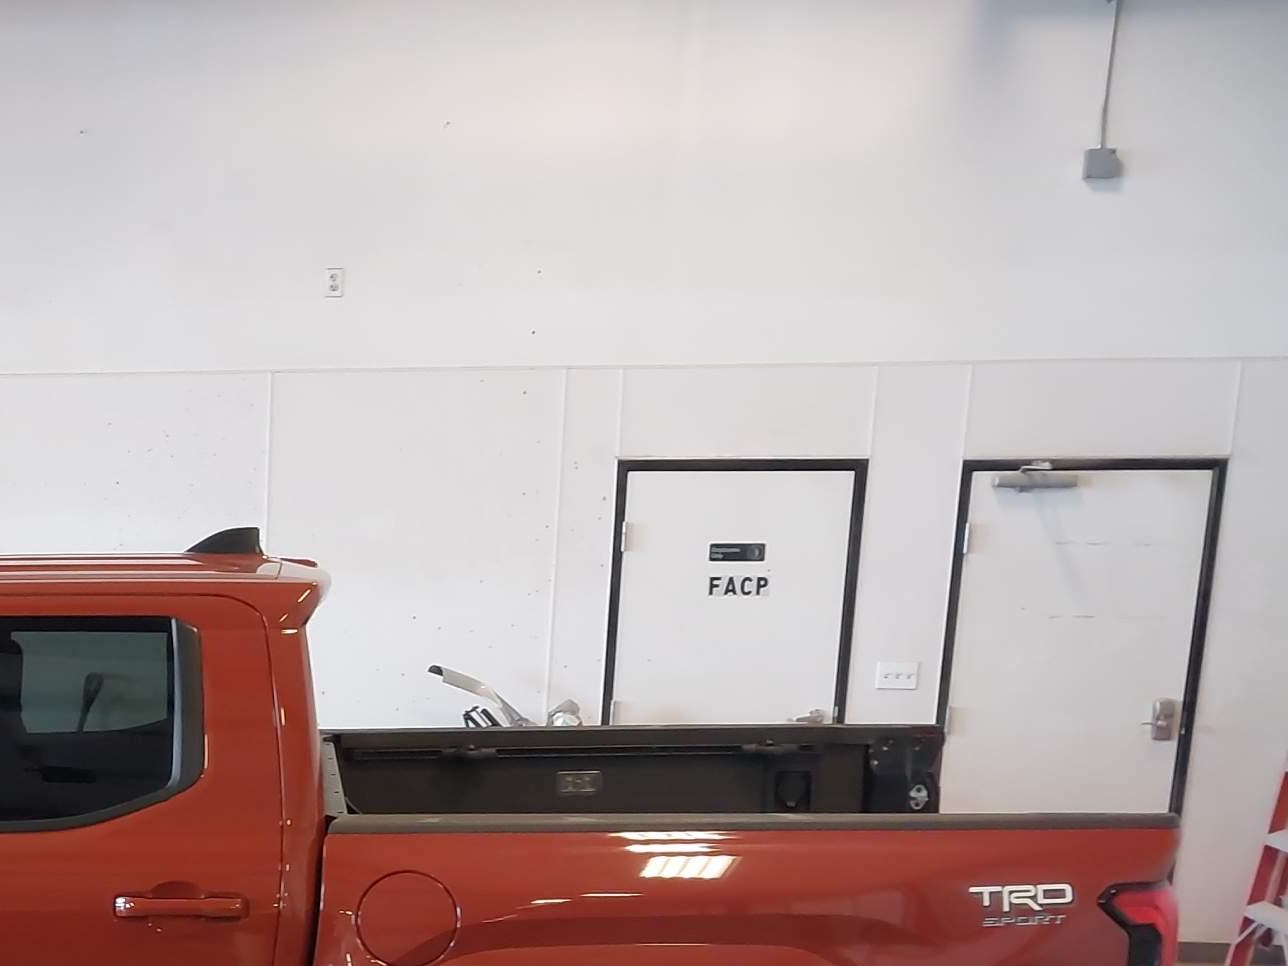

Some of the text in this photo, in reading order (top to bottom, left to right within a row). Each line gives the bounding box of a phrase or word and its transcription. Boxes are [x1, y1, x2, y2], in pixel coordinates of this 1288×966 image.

[709, 576, 769, 596] FACP
[968, 883, 1073, 912] TRD
[982, 914, 1067, 927] SPORT
